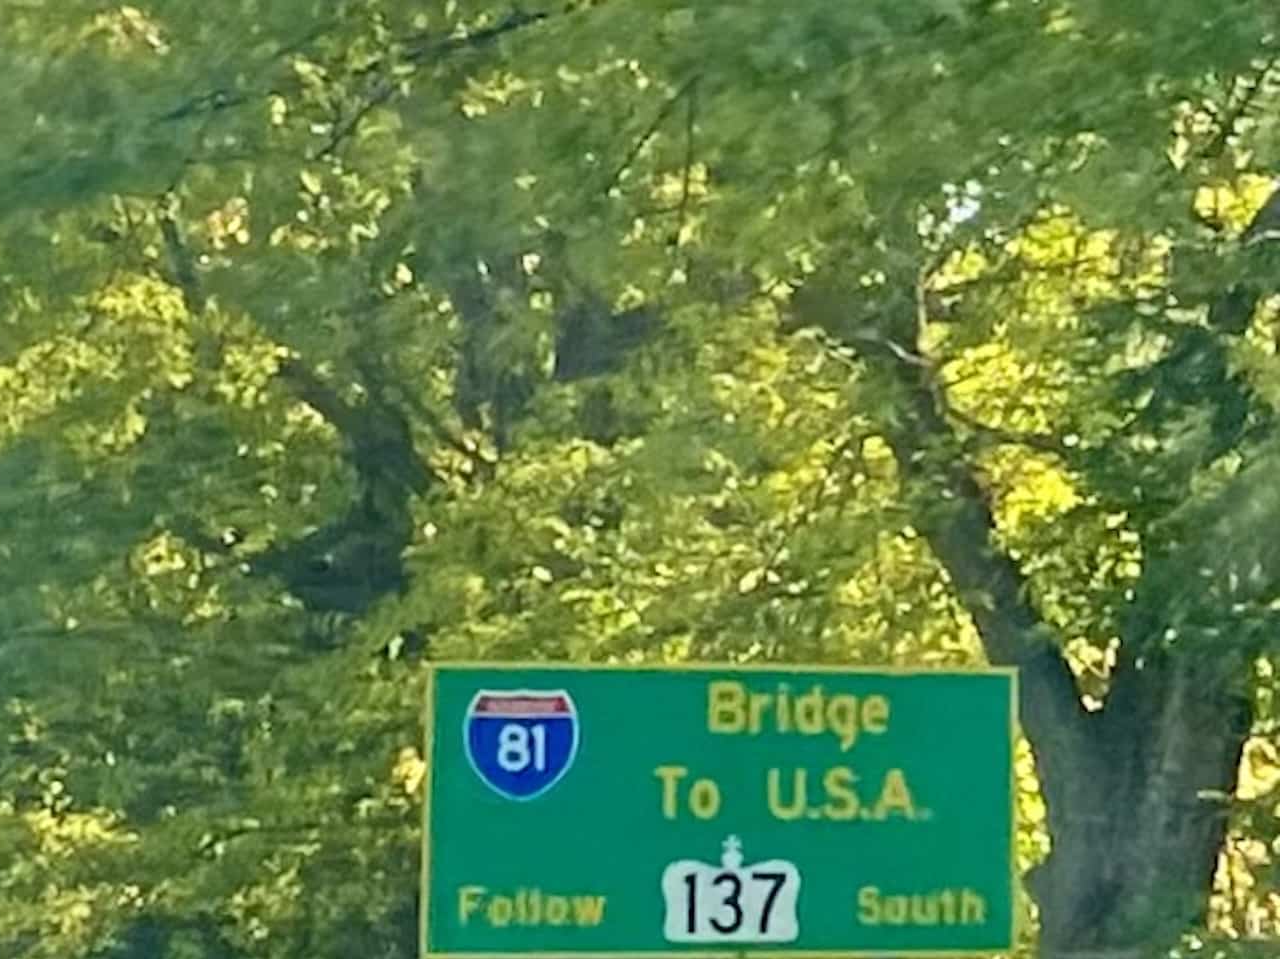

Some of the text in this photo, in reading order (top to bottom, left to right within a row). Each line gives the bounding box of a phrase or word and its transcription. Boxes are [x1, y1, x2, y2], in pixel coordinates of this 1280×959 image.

[706, 680, 890, 752] Bridge
[497, 723, 546, 772] 81
[654, 766, 719, 819] To
[456, 872, 986, 935] Follow 137 South
